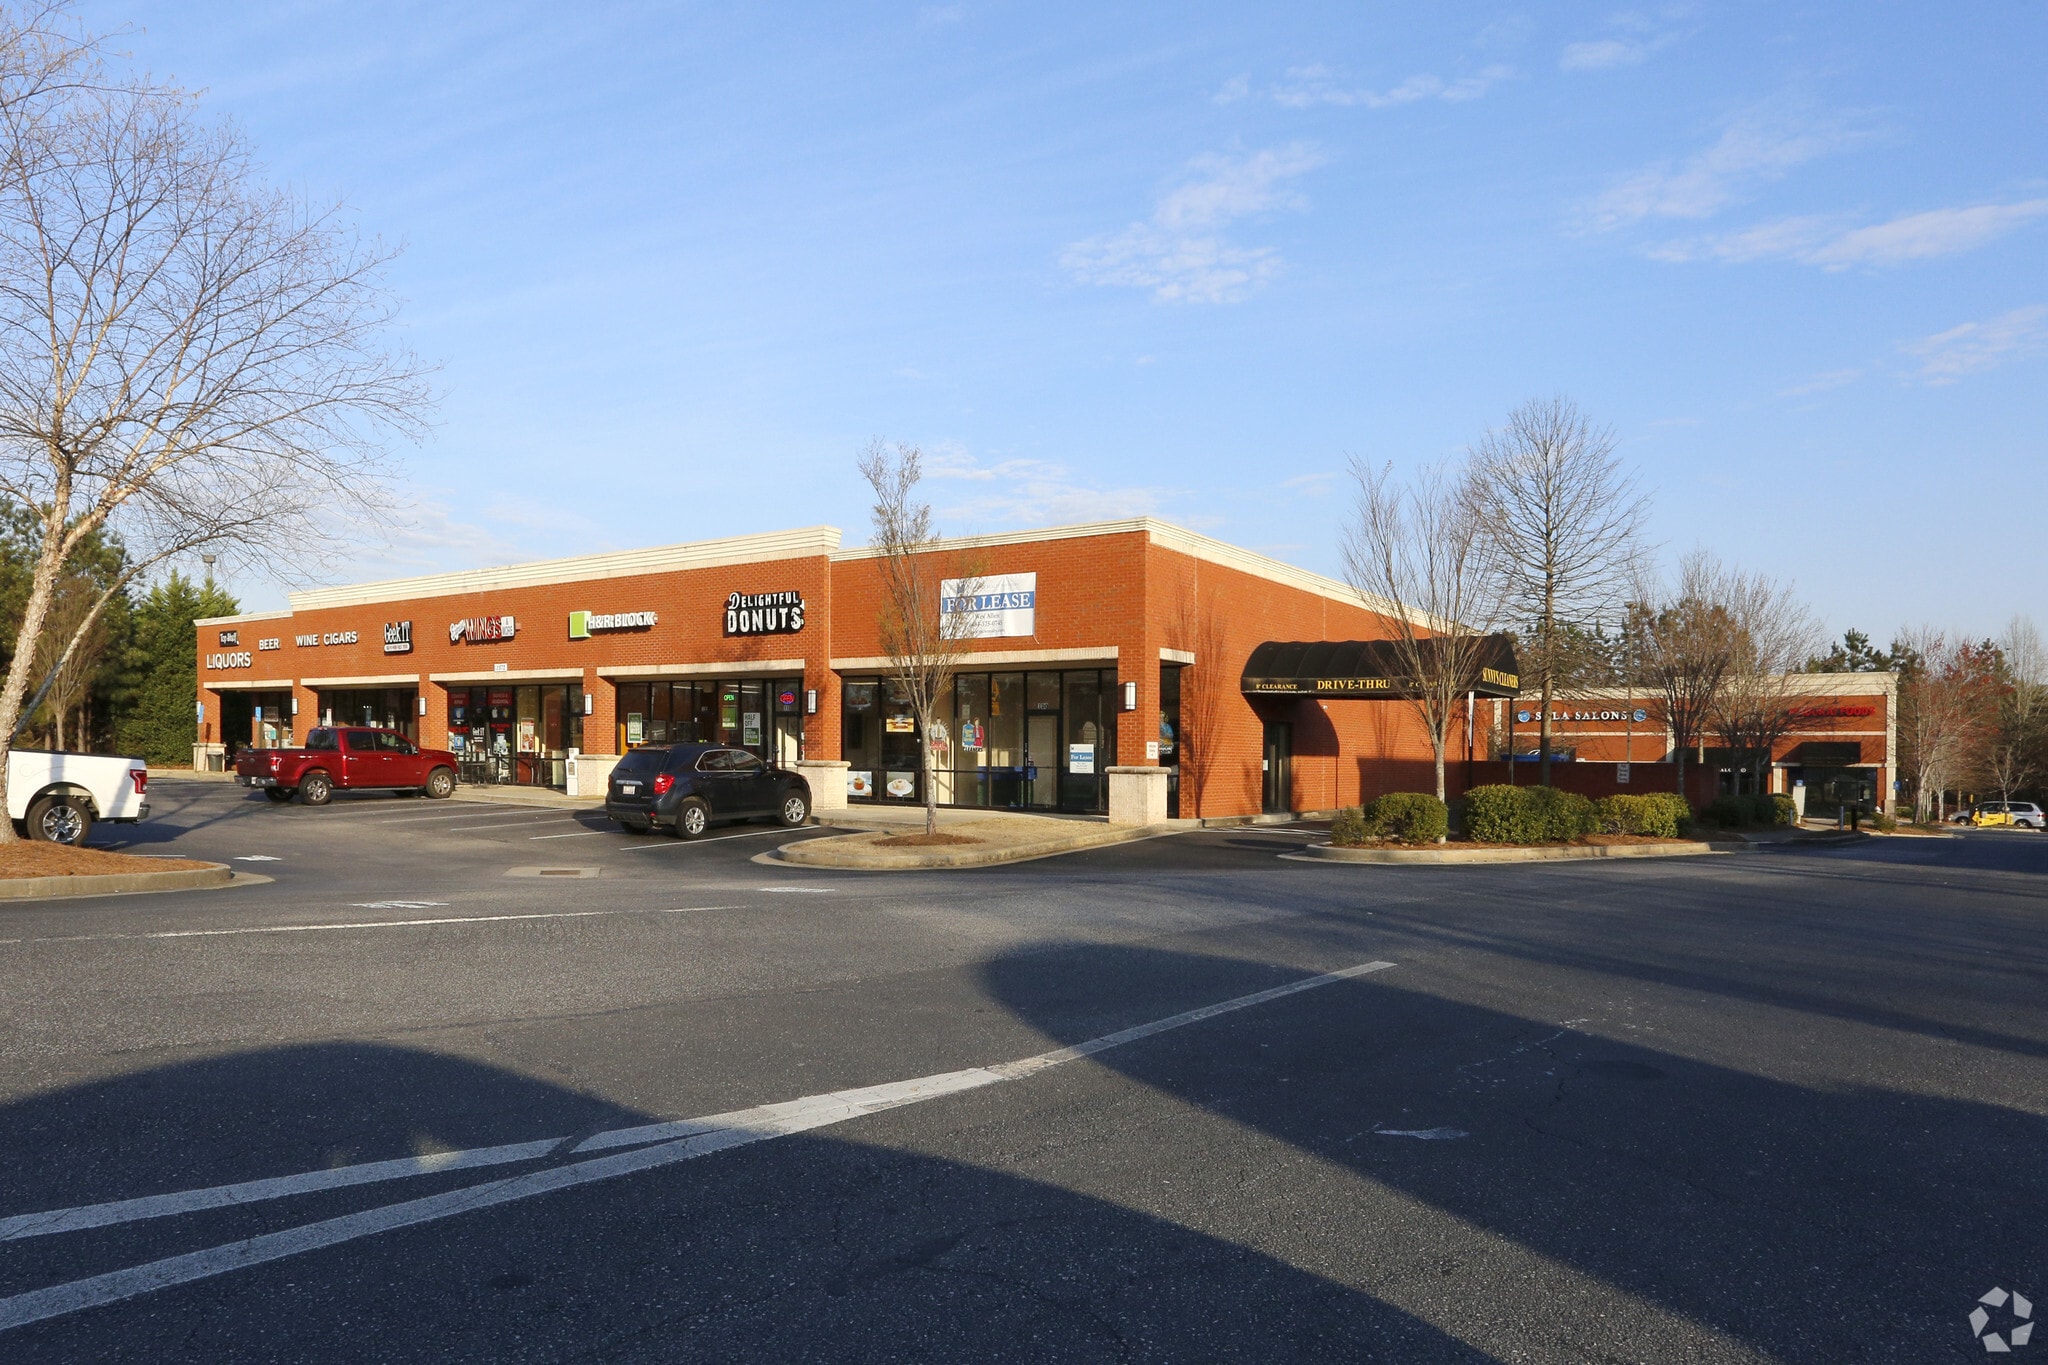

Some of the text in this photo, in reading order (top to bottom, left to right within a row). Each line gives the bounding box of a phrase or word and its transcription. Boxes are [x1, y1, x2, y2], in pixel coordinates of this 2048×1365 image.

[728, 592, 799, 609] DELIGHTFUL
[946, 593, 1031, 612] FOR LEASE
[464, 616, 501, 641] WINGS
[588, 611, 655, 629] H&R BLOCK
[728, 607, 801, 633] DONUTS
[295, 631, 358, 647] WINE CIGARS
[384, 621, 410, 643] Geek IT
[258, 638, 280, 650] BEER
[206, 652, 251, 670] LIQUORS
[1316, 679, 1391, 690] DRIVE-THRU
[1535, 711, 1628, 720] SLA SALONS
